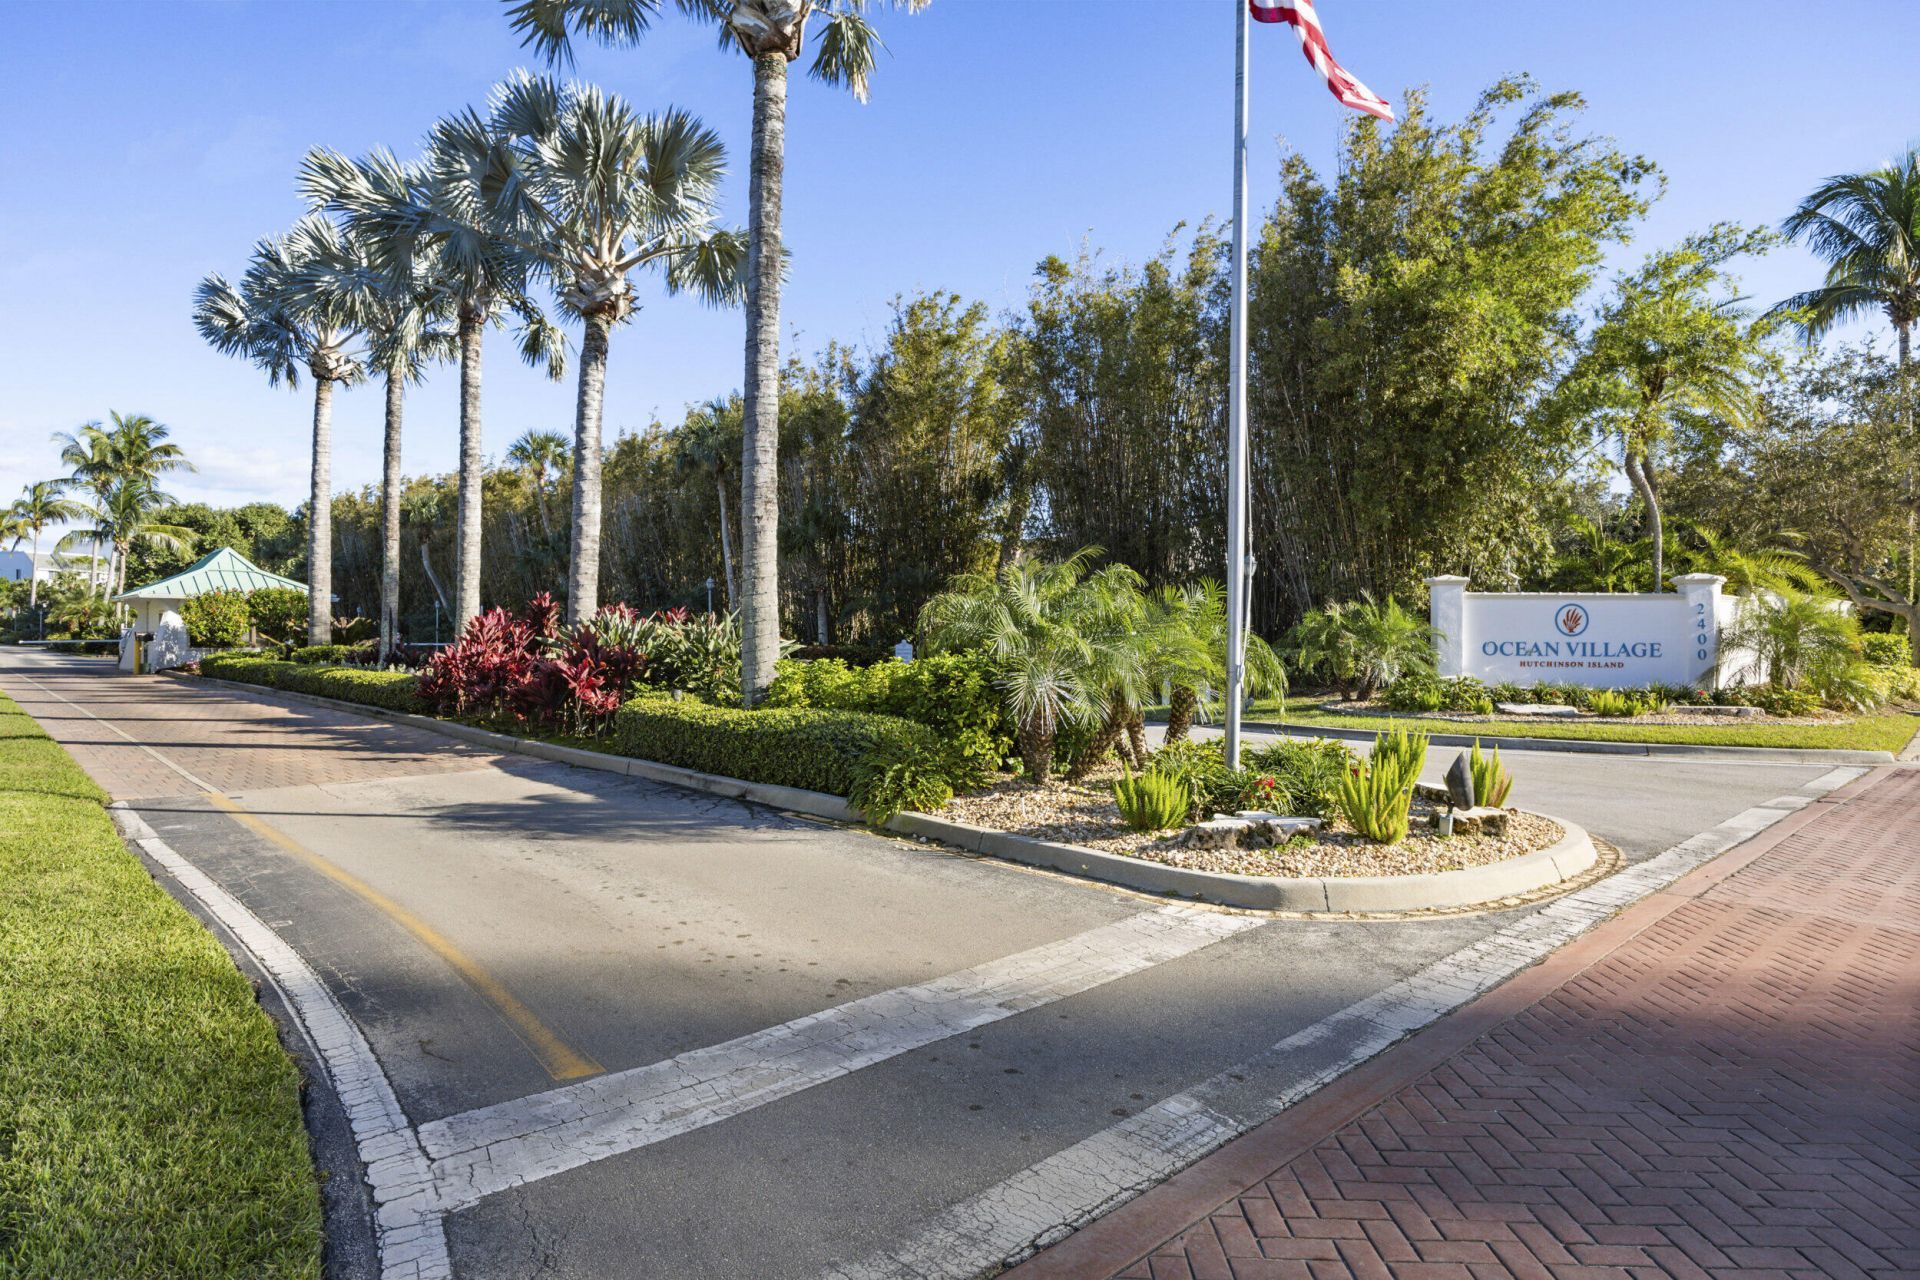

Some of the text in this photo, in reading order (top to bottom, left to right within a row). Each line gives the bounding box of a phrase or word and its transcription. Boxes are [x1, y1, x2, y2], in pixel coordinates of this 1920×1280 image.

[1697, 603, 1708, 661] 2400
[1482, 641, 1663, 658] OCEAN VILLAGE
[1519, 660, 1625, 669] HUTCHINSON ISLAND
